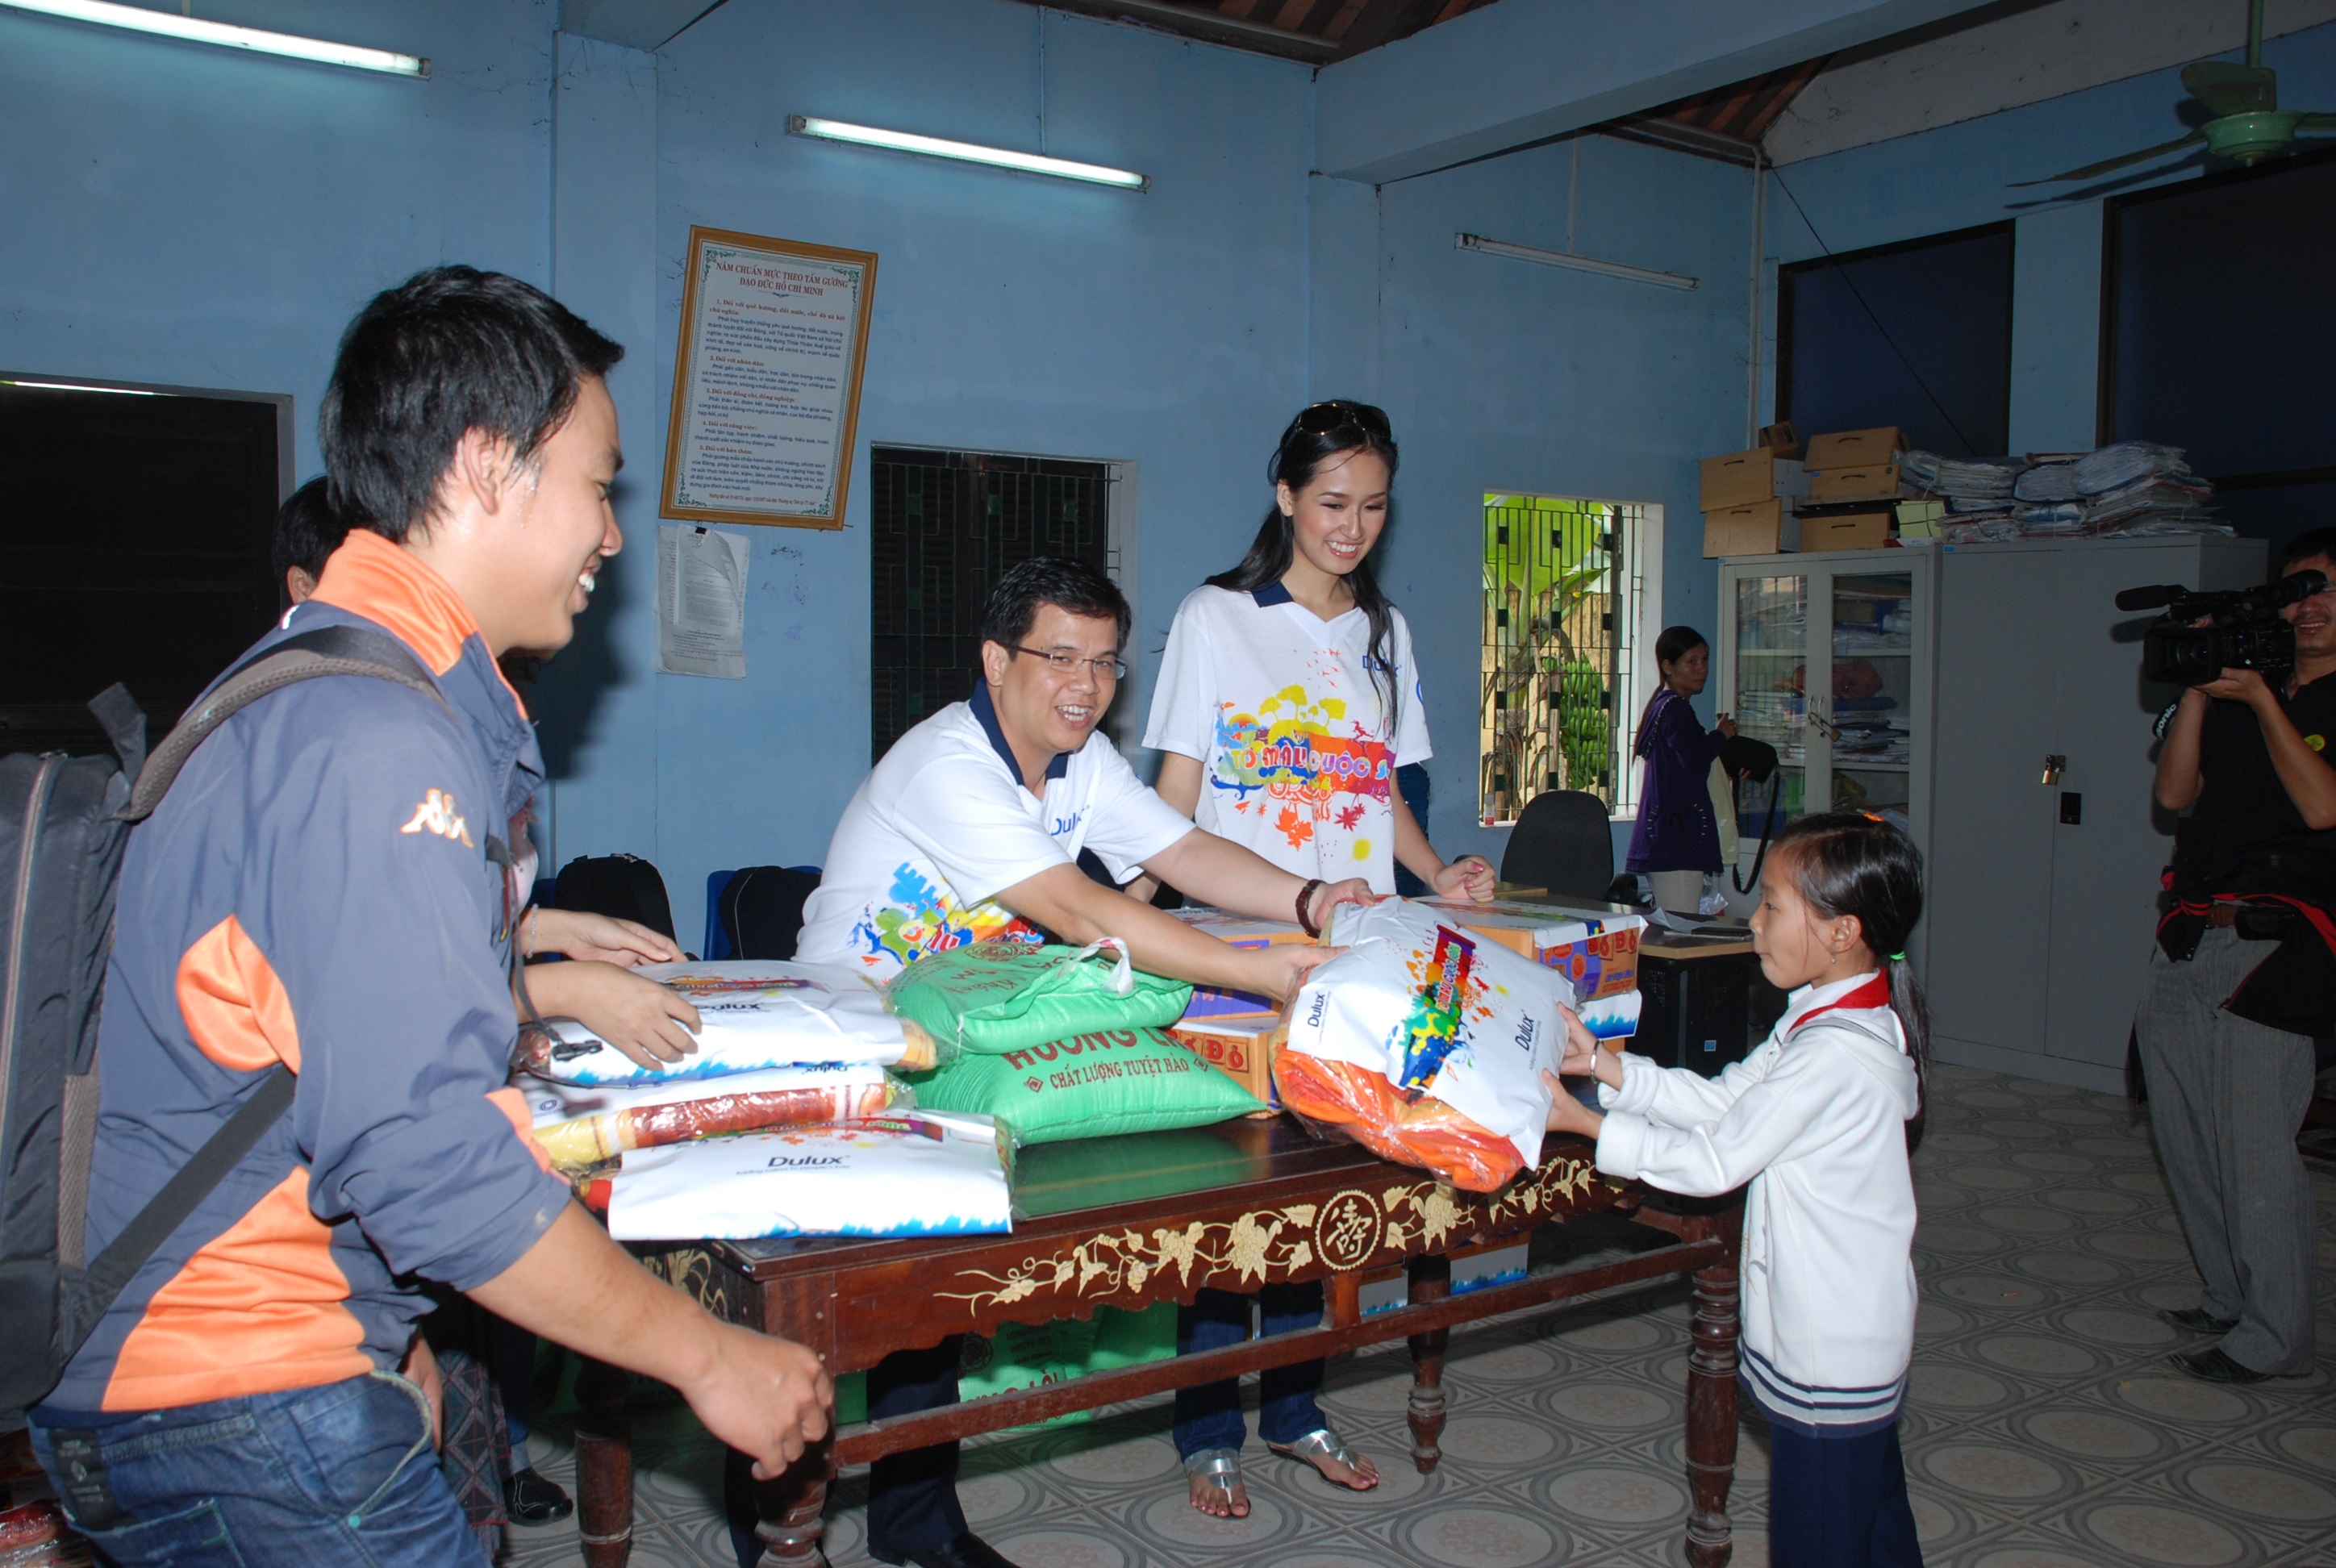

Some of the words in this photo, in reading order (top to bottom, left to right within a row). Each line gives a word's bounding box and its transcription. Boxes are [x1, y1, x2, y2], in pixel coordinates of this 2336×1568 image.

[735, 261, 762, 276] CHUẨN
[763, 267, 781, 280] MỰC
[782, 271, 803, 281] THEO
[804, 272, 820, 284] TẤM
[821, 276, 848, 289] GƯƠNG
[739, 276, 756, 288] ĐẠO
[757, 277, 774, 289] ĐỨC
[774, 278, 787, 291] HỒ
[787, 281, 802, 293] CHÍ
[803, 285, 823, 296] MINH
[1261, 740, 1308, 768] MÀU
[1308, 750, 1371, 782] CUỘC
[1308, 993, 1325, 1028] Dulux
[1515, 1013, 1534, 1051] Dulux
[1049, 1063, 1082, 1089] CHẤT
[1082, 1060, 1123, 1083] LƯỢNG
[1124, 1055, 1162, 1078] TUYỆT
[767, 1155, 844, 1167] Dulux
